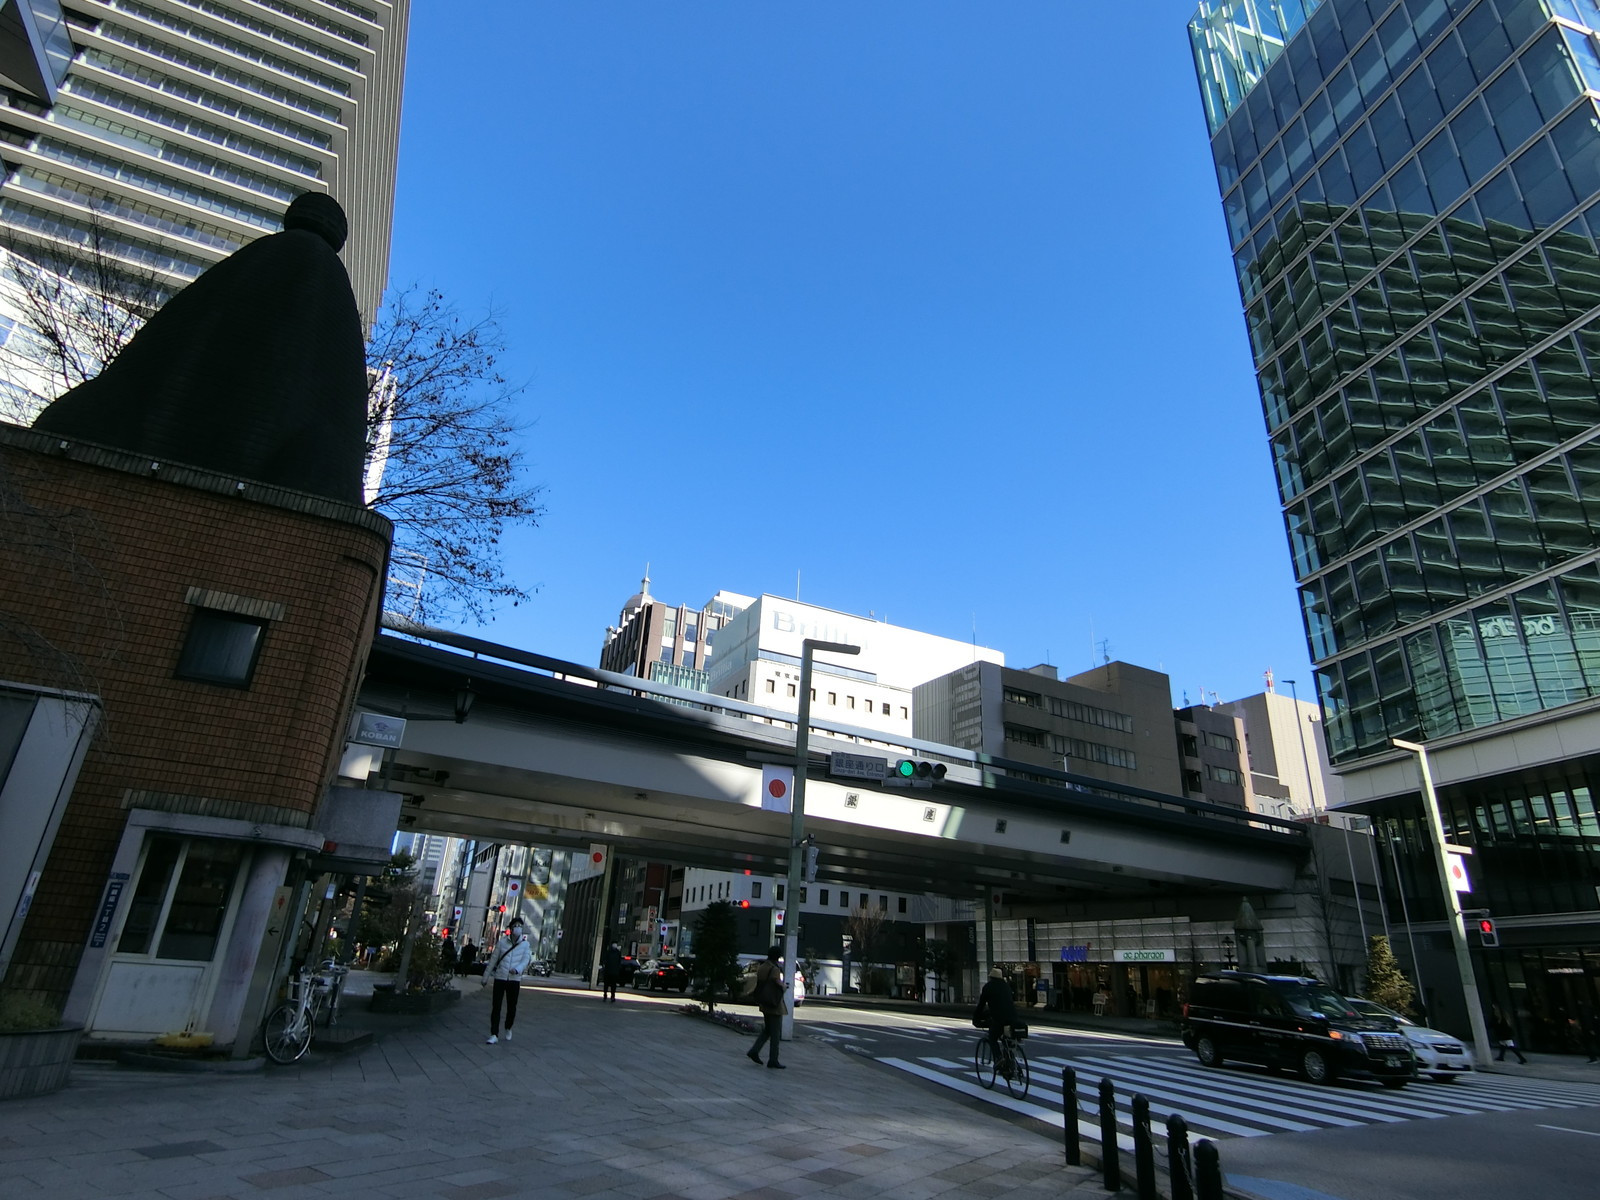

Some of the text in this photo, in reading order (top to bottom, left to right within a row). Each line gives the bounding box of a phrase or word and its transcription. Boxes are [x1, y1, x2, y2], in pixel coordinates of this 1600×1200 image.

[361, 730, 396, 741] KOBAN
[835, 758, 884, 772] 銀座通り口
